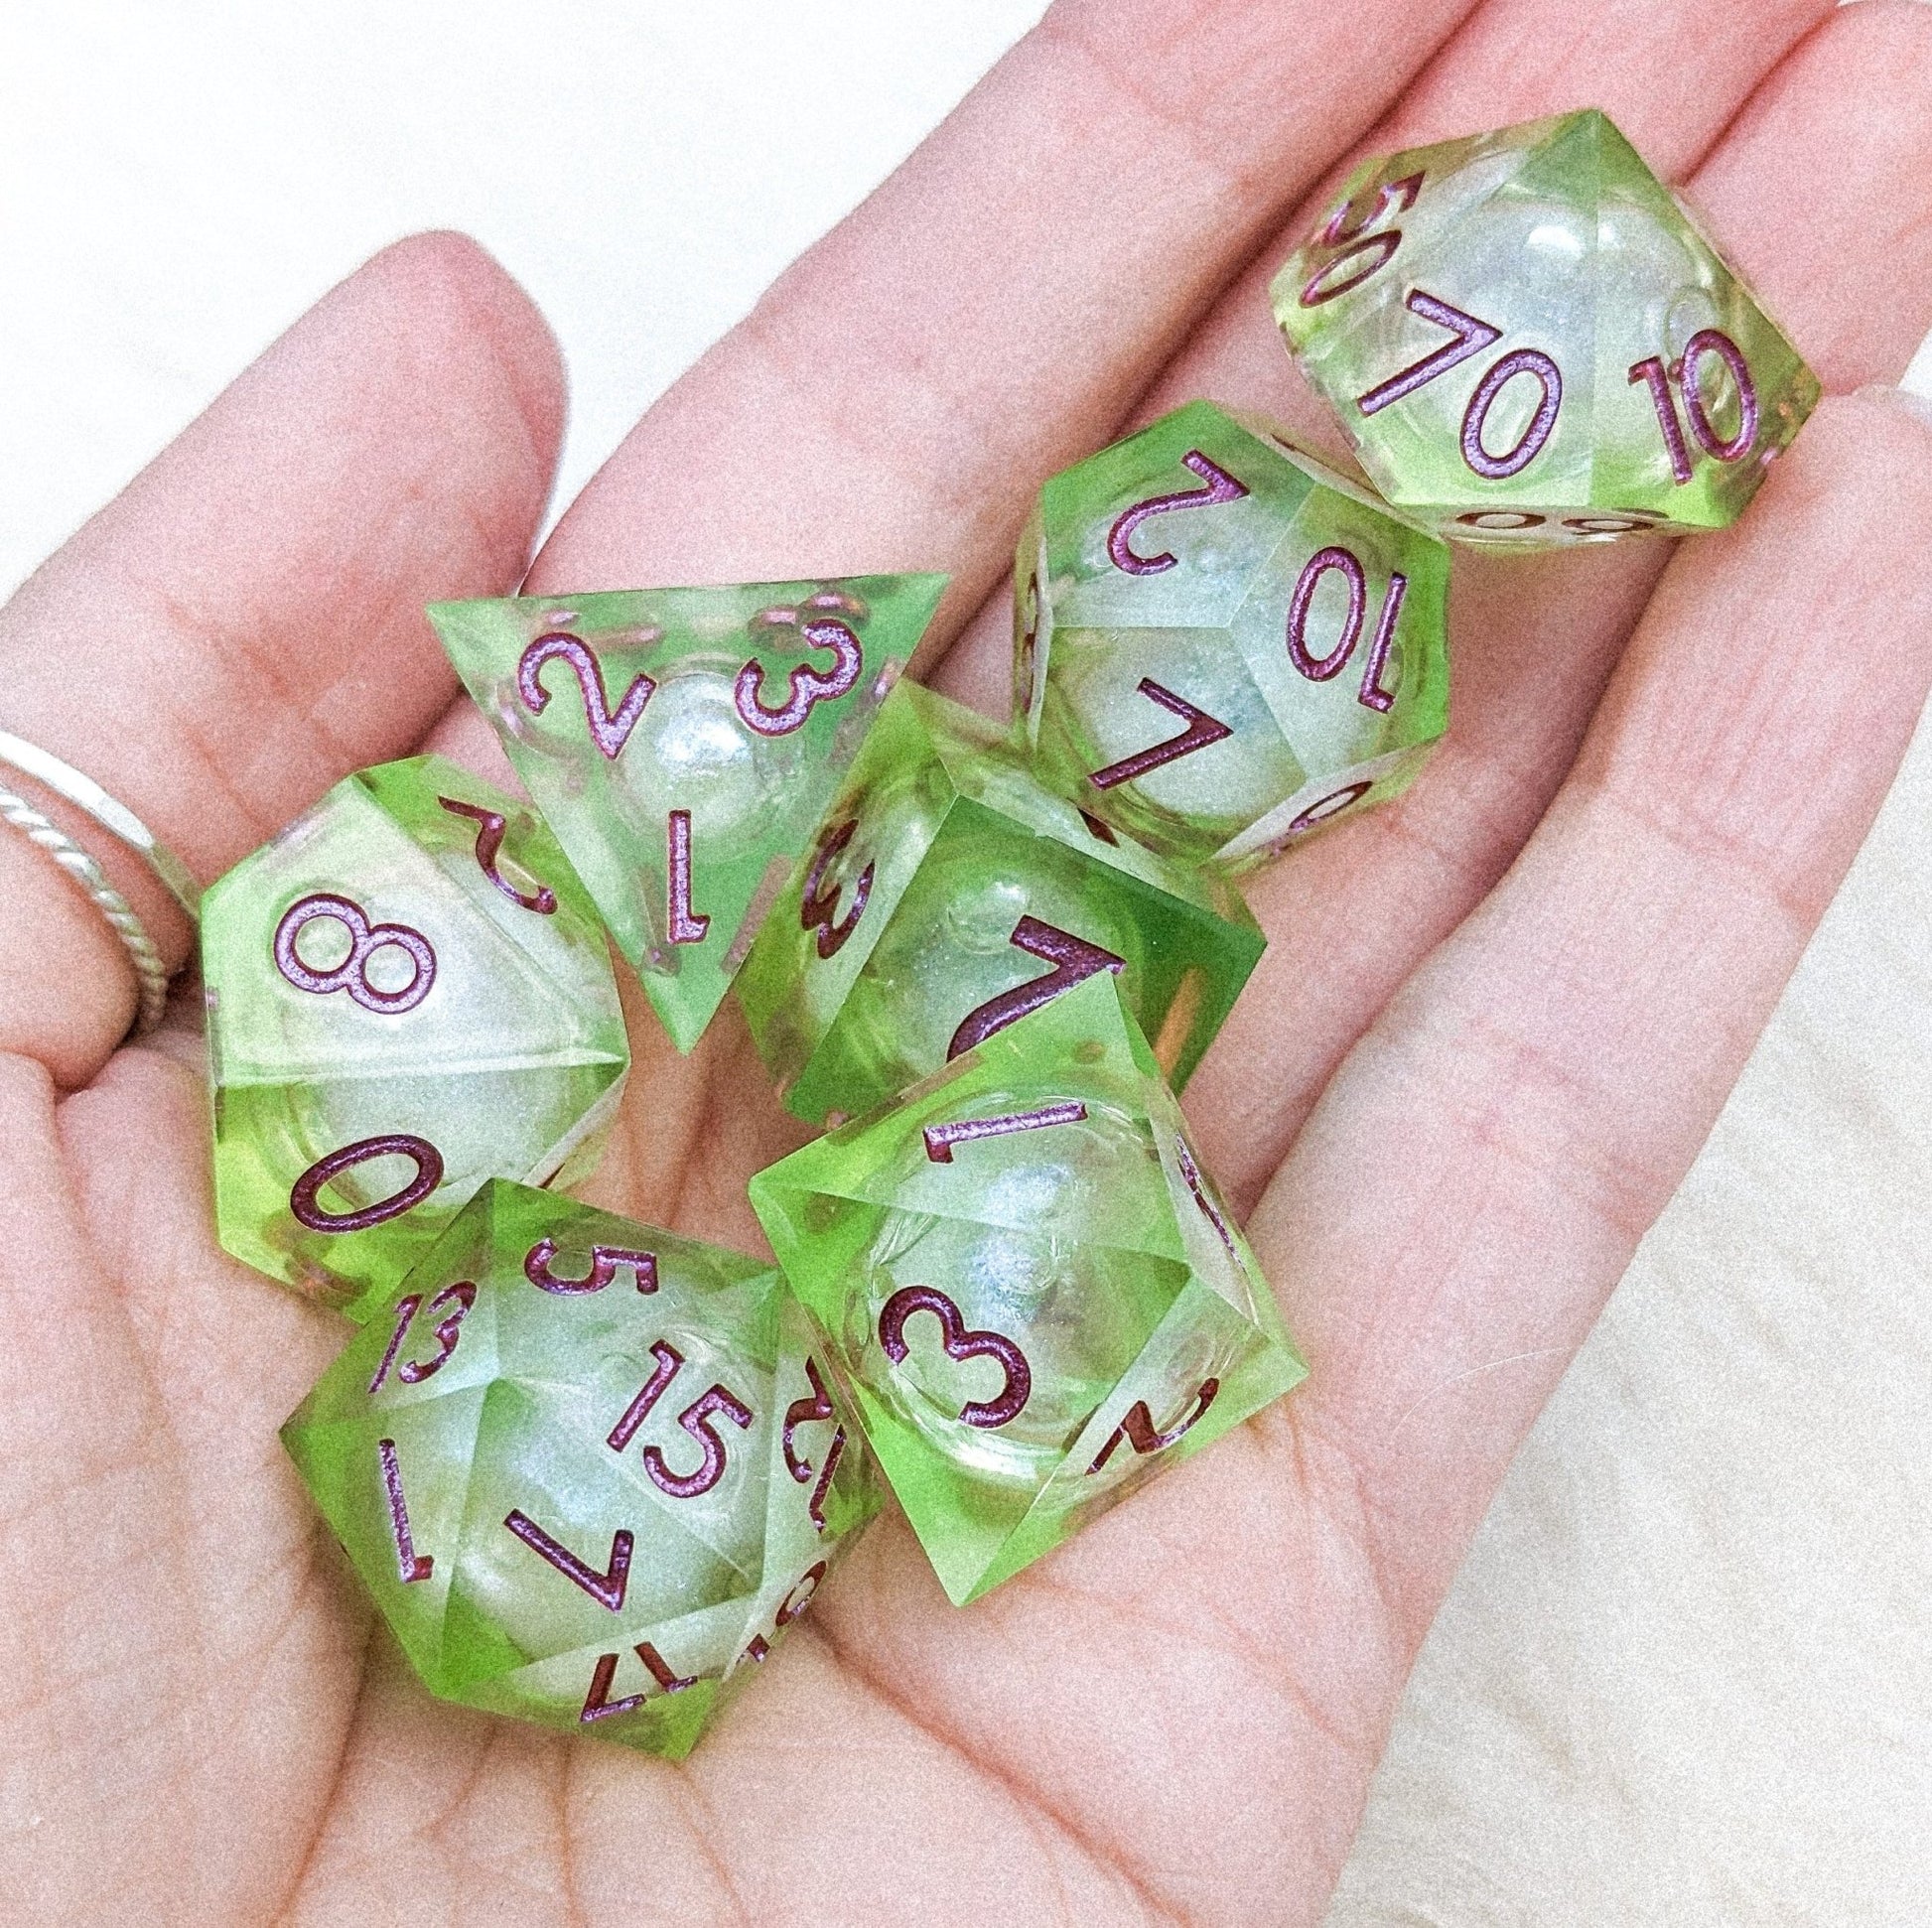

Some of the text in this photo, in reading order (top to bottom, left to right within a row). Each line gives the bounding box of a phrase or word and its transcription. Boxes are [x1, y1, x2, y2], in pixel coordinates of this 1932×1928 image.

[1299, 170, 1427, 309] 50
[1356, 288, 1563, 481] 70
[1627, 329, 1758, 486] 10
[1107, 449, 1251, 577] 2
[734, 619, 864, 737] 3
[1287, 546, 1409, 714] 10
[518, 631, 657, 760] 2
[1087, 677, 1234, 790] 7
[438, 795, 559, 915] 2
[666, 809, 712, 944] 1
[800, 818, 876, 960] 3
[273, 894, 438, 1016] 8
[290, 1134, 445, 1234] 0
[922, 1101, 1088, 1164] 1
[524, 1237, 659, 1296] 5
[367, 1281, 478, 1394] 13
[879, 1285, 1032, 1429] 3
[607, 1338, 755, 1498] 15
[1084, 1377, 1219, 1476] 2
[379, 1438, 434, 1584] 1
[503, 1507, 634, 1613] 7
[579, 1641, 699, 1723] 17
